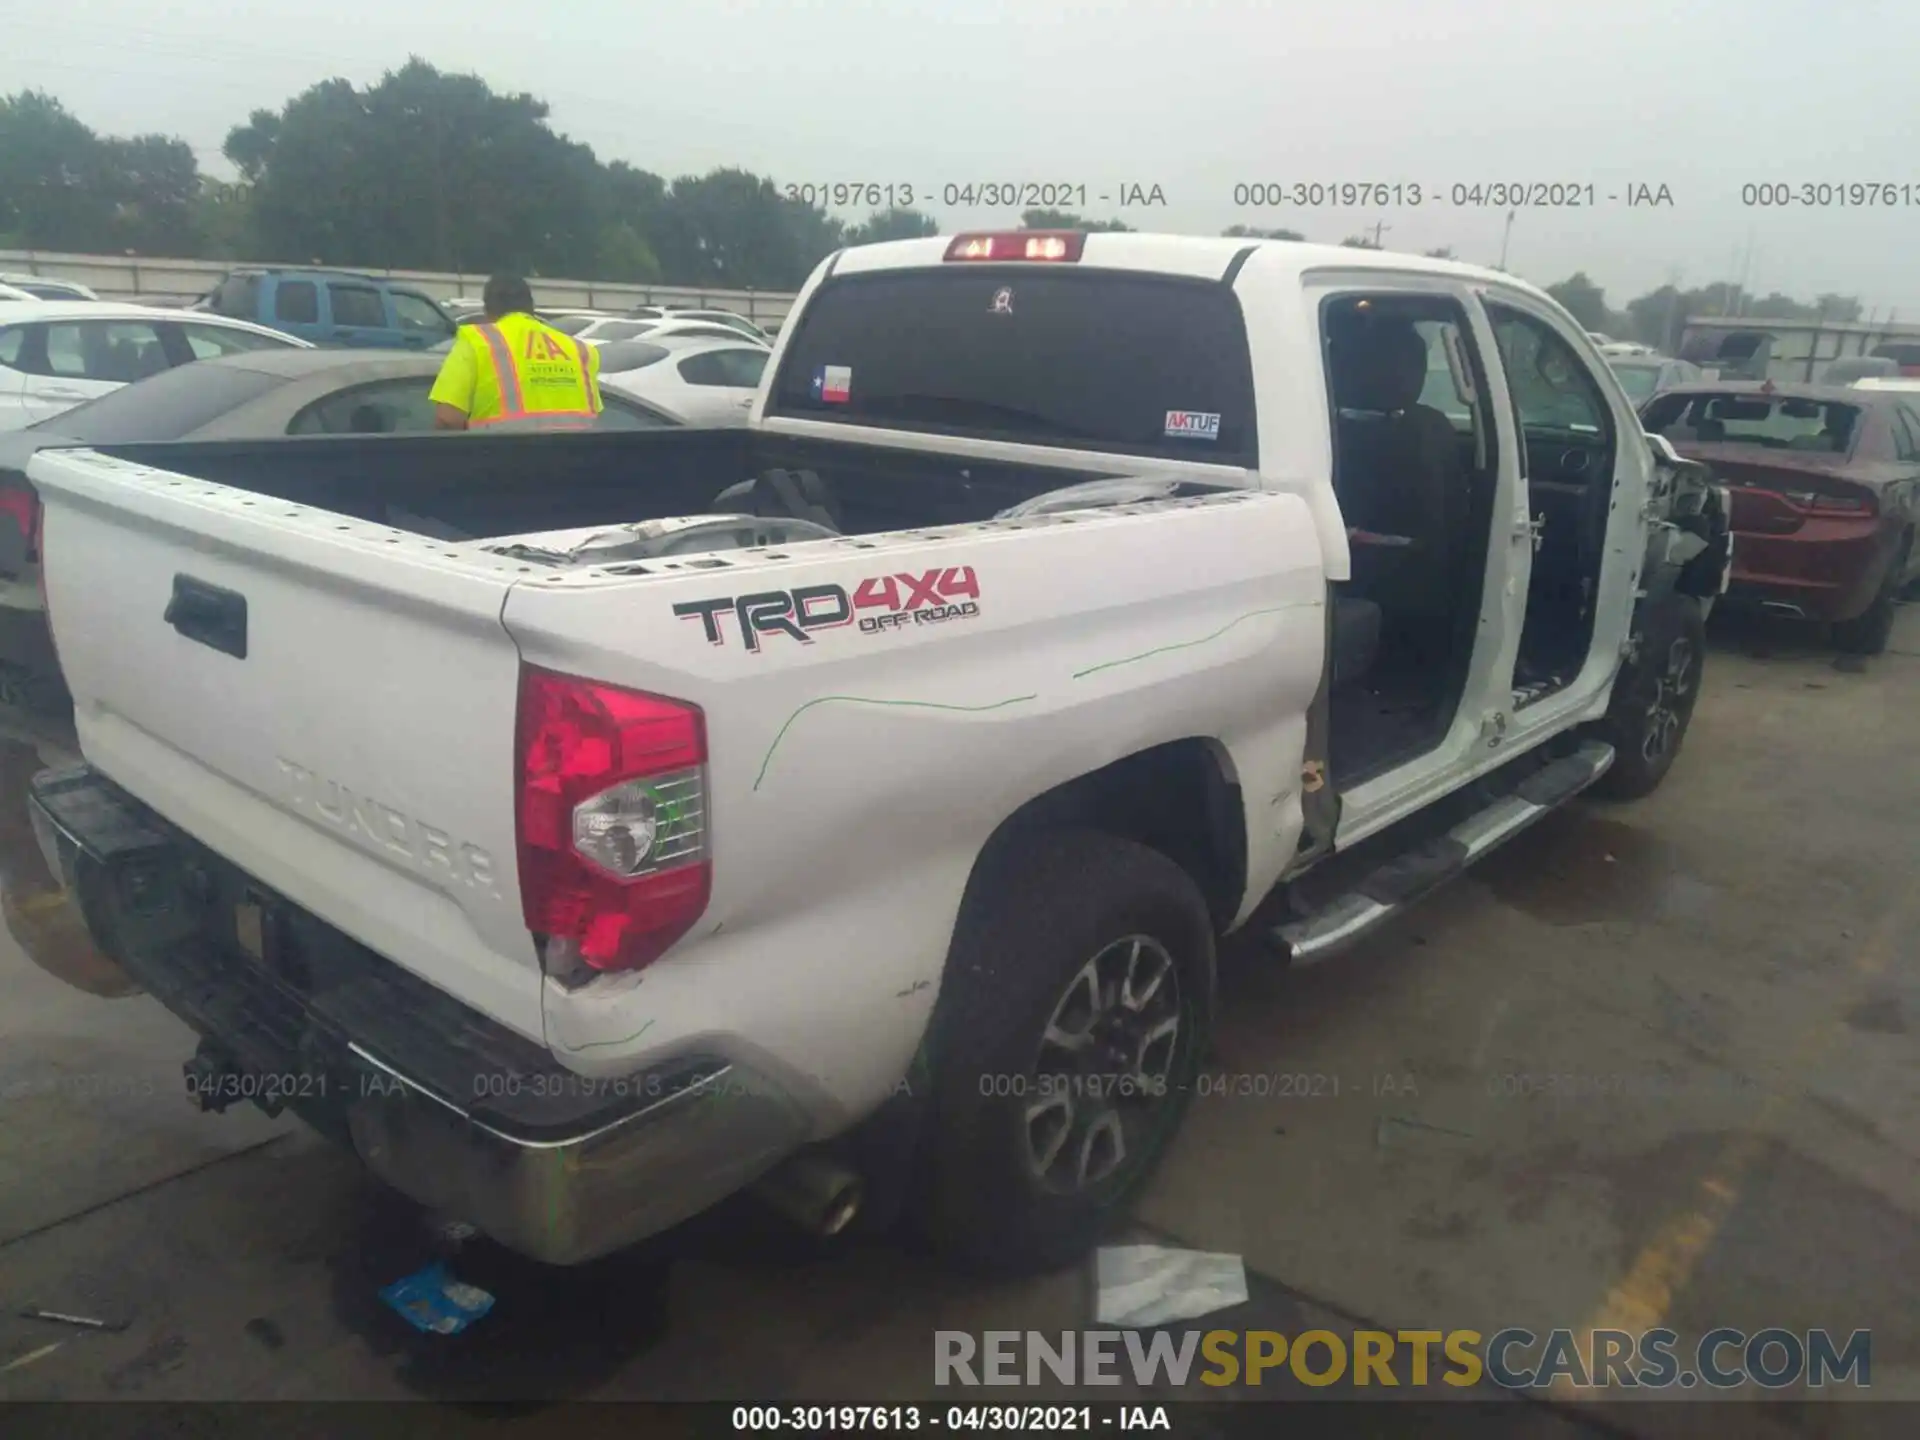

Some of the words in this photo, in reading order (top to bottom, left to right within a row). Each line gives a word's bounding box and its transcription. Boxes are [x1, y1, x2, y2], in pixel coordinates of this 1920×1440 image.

[672, 584, 855, 653] TRD
[858, 613, 912, 635] OFF
[913, 601, 981, 624] ROAD
